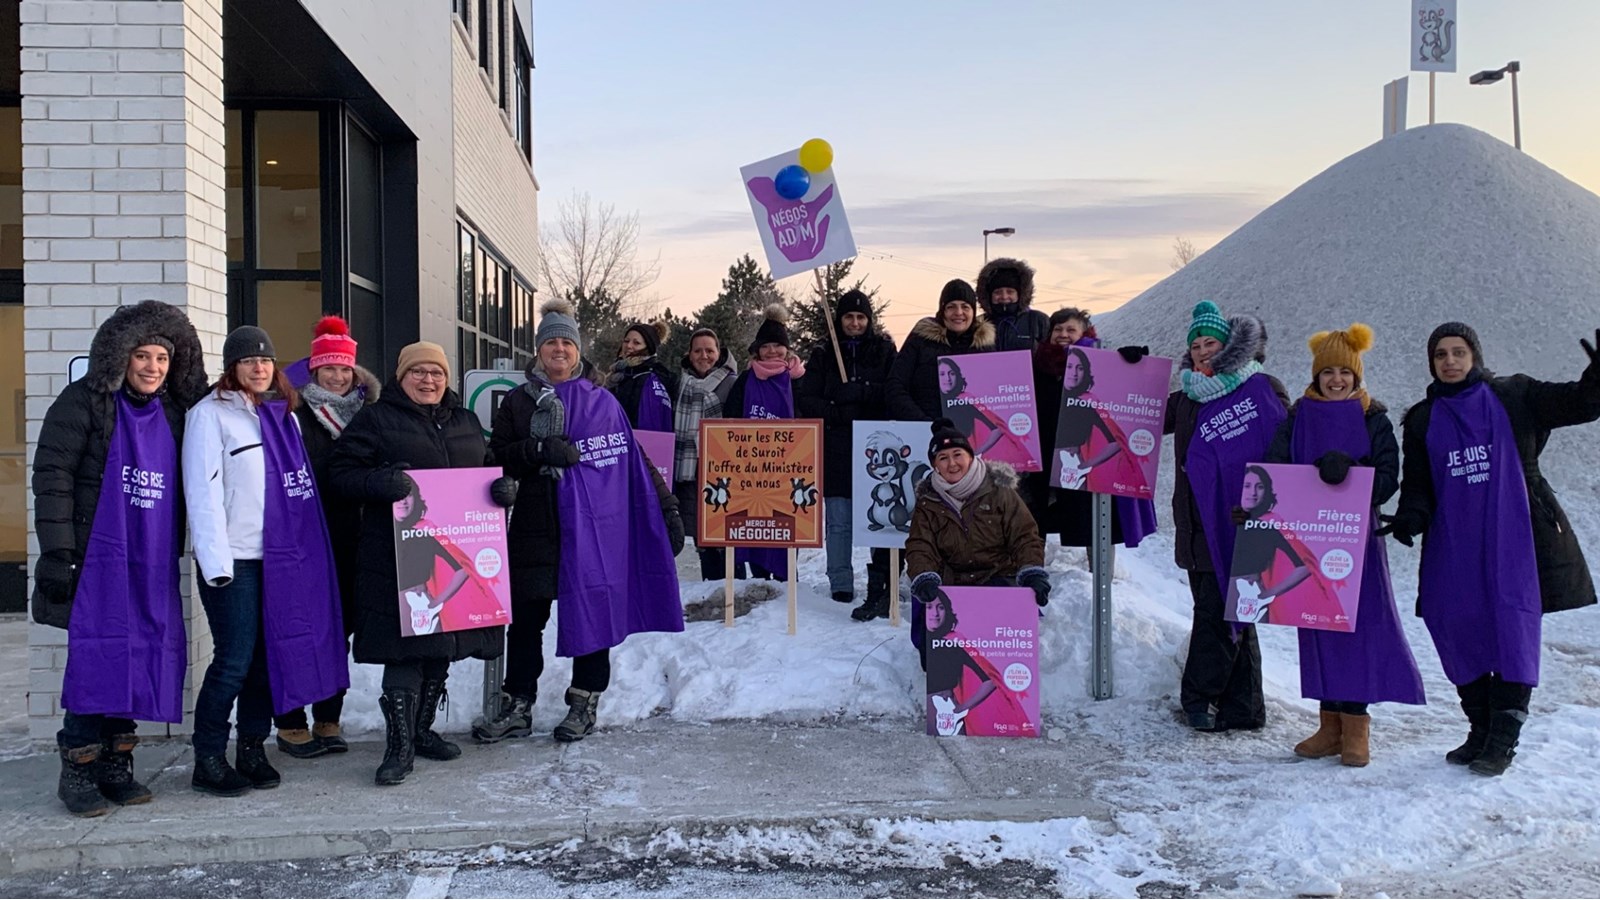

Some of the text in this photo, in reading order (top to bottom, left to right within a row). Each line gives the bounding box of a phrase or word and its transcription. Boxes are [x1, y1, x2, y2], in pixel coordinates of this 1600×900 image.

[771, 204, 808, 228] NÉGOS
[998, 384, 1030, 394] Fières
[946, 393, 1031, 408] professionnelles
[1127, 393, 1162, 407] Fières
[749, 404, 759, 416] JE
[1066, 397, 1161, 418] professionnelles
[1200, 422, 1211, 438] JE
[1210, 409, 1234, 429] SUIS
[587, 435, 608, 451] SUIS
[607, 431, 628, 447] RSE
[727, 430, 794, 443] Pour les RSE
[736, 446, 786, 458] de Suroît
[1447, 450, 1461, 467] JE
[708, 460, 815, 474] l'offre du Ministère
[1451, 466, 1467, 477] QUE
[1465, 463, 1478, 474] EST
[283, 472, 297, 487] JE
[740, 480, 781, 491] ça nous
[464, 511, 500, 522] Fières
[1318, 509, 1362, 522] Fières
[745, 520, 776, 528] MERCI DE
[1244, 518, 1360, 534] professionnelles
[401, 522, 501, 541] professionnelles
[729, 526, 791, 540] NÉGOCIER
[440, 538, 449, 546] de
[1295, 533, 1302, 541] la
[1304, 534, 1326, 543] petite
[1328, 535, 1359, 544] enfance
[995, 626, 1033, 637] Fières
[932, 637, 1033, 649] professionnelles
[987, 650, 1006, 658] petite
